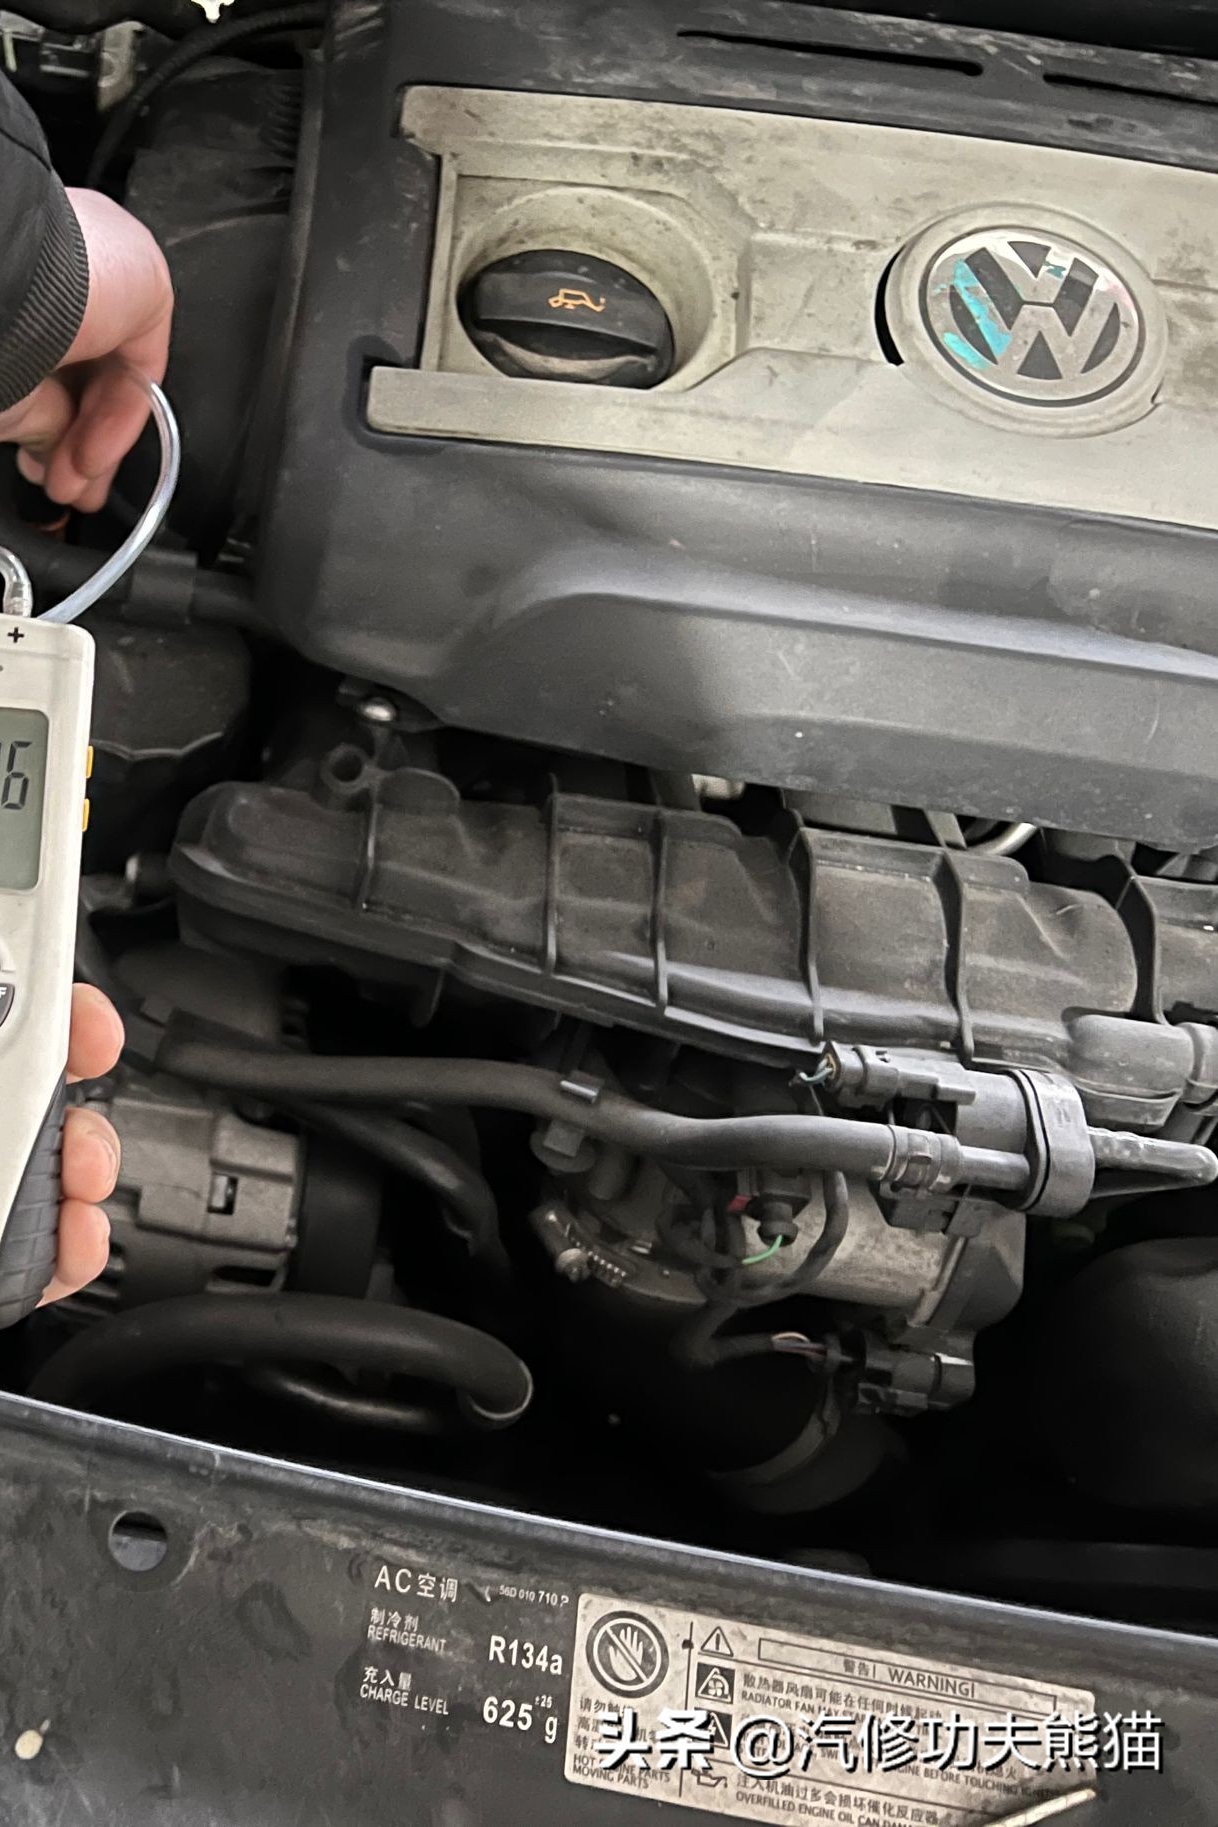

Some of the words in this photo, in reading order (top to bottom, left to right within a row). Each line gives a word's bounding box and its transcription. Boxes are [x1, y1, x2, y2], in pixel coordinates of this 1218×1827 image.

[538, 1590, 558, 1606] 710
[370, 1607, 419, 1632] 制冷剂
[366, 1624, 447, 1653] REFRIGERANT
[488, 1634, 563, 1675] R134a
[362, 1666, 412, 1691] 充入量
[360, 1683, 409, 1707] CHARGE
[414, 1695, 449, 1715] LEVEL
[741, 1690, 792, 1709] RADIATOR
[795, 1702, 815, 1714] FAN
[483, 1695, 533, 1731] 625
[544, 1716, 558, 1744] g
[573, 1754, 596, 1766] HOT
[573, 1764, 614, 1782] MOVING
[618, 1773, 649, 1789] PARTS
[924, 1768, 960, 1785] BEFORE
[736, 1791, 795, 1812] OVERFILLED
[799, 1803, 834, 1820] ENGINE
[838, 1811, 854, 1824] OIL
